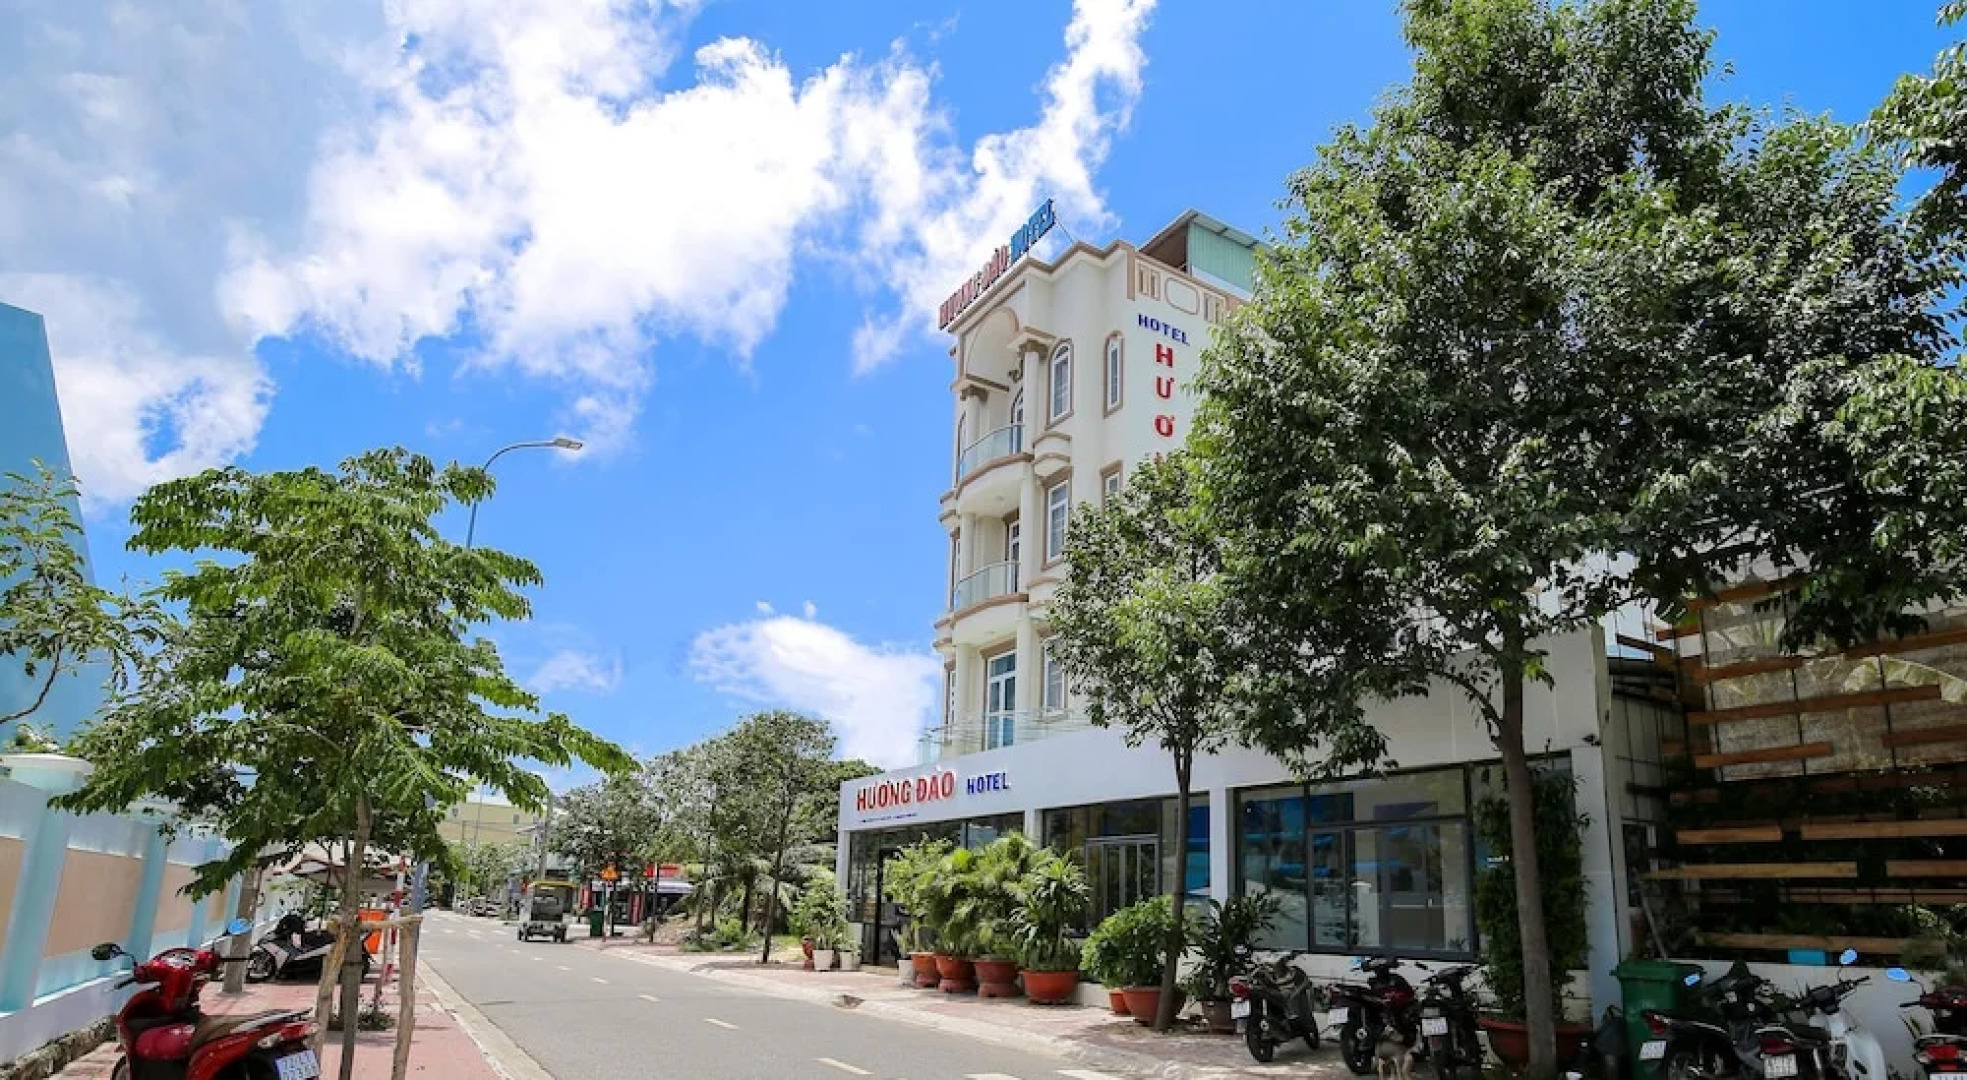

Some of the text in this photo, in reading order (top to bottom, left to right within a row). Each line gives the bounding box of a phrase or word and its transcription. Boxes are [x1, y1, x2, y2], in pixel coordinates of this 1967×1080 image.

[1138, 313, 1190, 346] HOTEL
[1155, 343, 1175, 462] HƯƠ
[857, 778, 912, 811] HƯƠNG
[967, 772, 1010, 794] HOTEL
